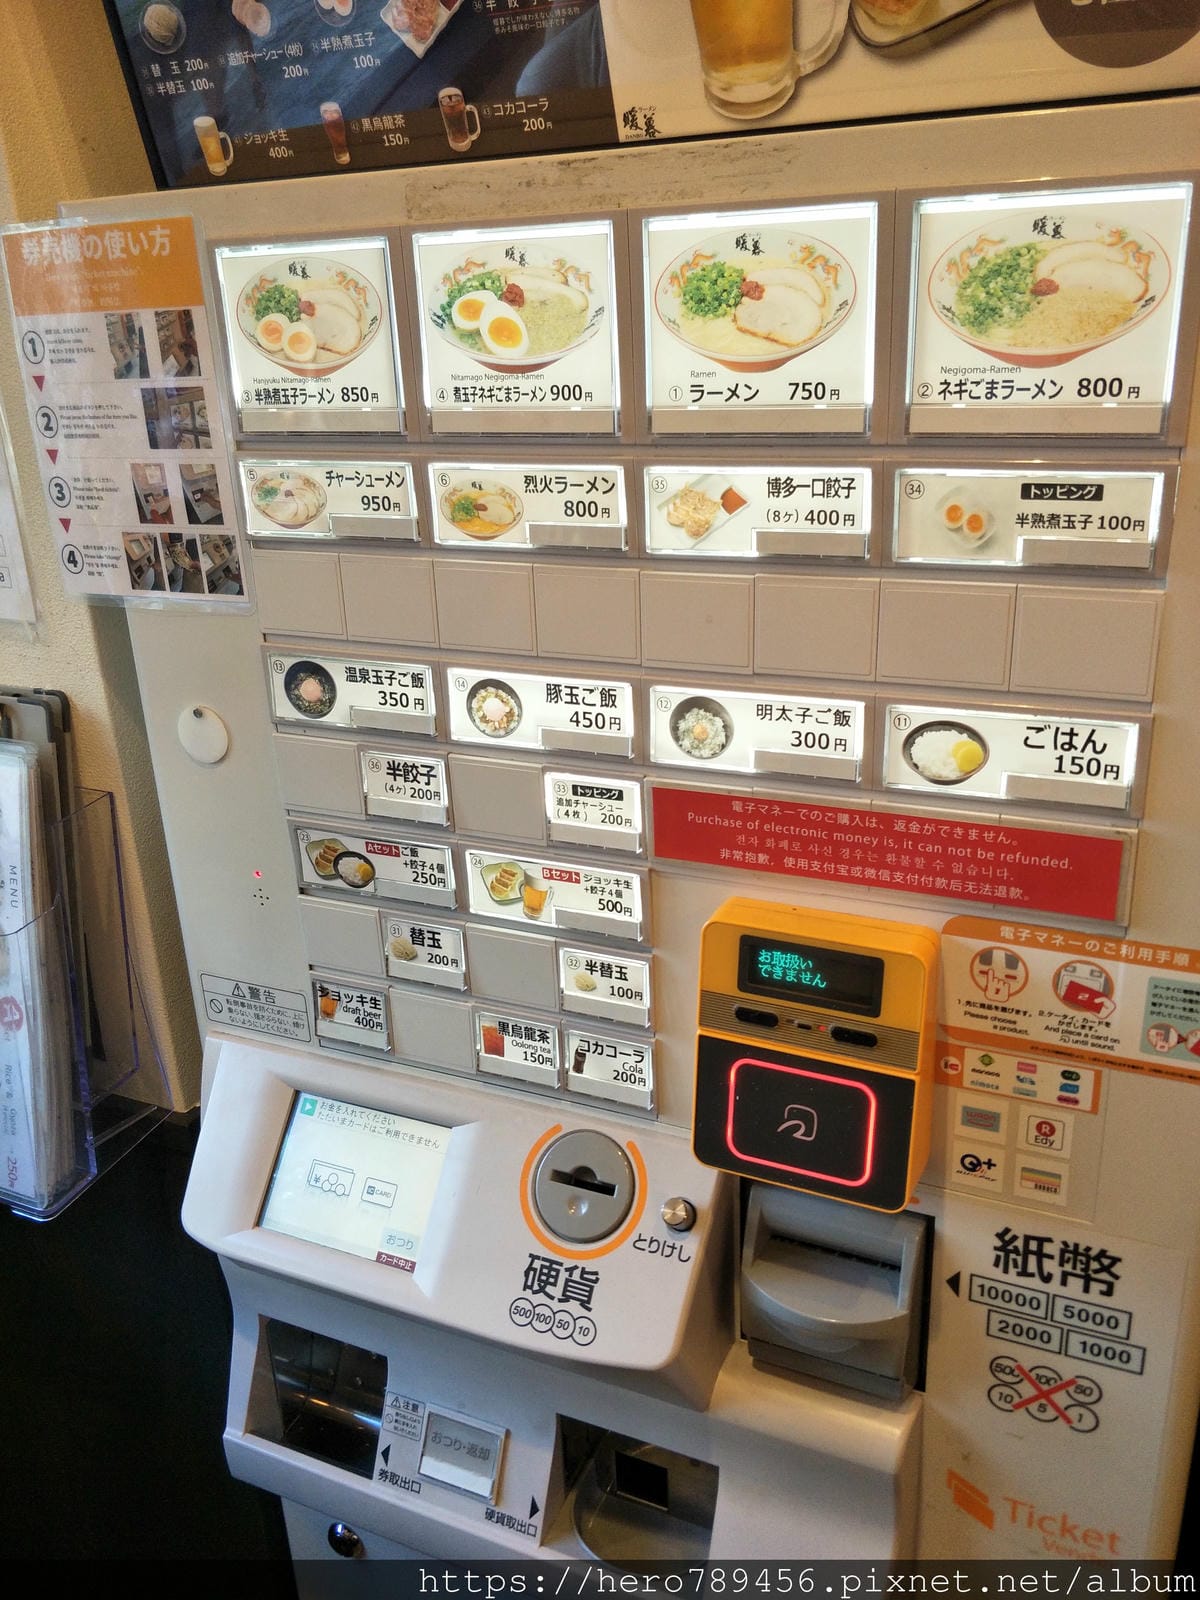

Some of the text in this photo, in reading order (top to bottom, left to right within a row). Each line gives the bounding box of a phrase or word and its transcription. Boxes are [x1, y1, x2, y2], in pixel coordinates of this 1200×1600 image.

[319, 32, 376, 53] 半熟煮玉子
[352, 54, 381, 69] 100円
[157, 80, 186, 96] 半替玉
[493, 97, 549, 116] コカコーラ
[244, 128, 289, 144] ジョッキ生
[451, 373, 483, 382] Nitamago
[690, 370, 717, 378] Ramen
[940, 365, 1021, 376] Negigoma-Ramen
[255, 387, 335, 405] 半熟煮玉子ラーメン
[453, 386, 547, 403] 煮玉子ネギごまラーメン
[689, 382, 760, 403] ラーメン
[937, 378, 1064, 401] ネギごまラーメン
[325, 470, 405, 488] チャーシューメン
[523, 475, 616, 495] 烈火ラーメン
[766, 476, 856, 499] 博多一口餃子
[1029, 484, 1098, 500] トッピング
[1015, 512, 1093, 531] 半熟煮玉子
[344, 666, 424, 689] 温泉玉子ご飯
[545, 683, 617, 709] 豚玉ご飯
[756, 703, 852, 728] 明太子ご飯
[1023, 724, 1108, 755] ごはん
[386, 760, 437, 786] 半餃子
[577, 785, 619, 799] トッピング
[556, 796, 624, 812] 追加チャーシュー
[731, 800, 1018, 846] 電子マネーでのご購入は、返金ができません。
[687, 812, 1073, 871] Purchase of electronic money is, it can not be refunded.
[401, 846, 419, 858] ご飯
[932, 860, 945, 871] 수
[9, 864, 19, 909] MENU
[543, 868, 633, 890] Bセット ジョッキ生
[409, 926, 442, 950] 替玉
[999, 925, 1190, 967] 電子マネーのご利用手順
[757, 949, 813, 969] お取扱い
[584, 959, 629, 982] 半替玉
[757, 963, 827, 988] できません
[247, 986, 276, 1004] 警告
[343, 1004, 382, 1020] draft beer
[963, 1011, 1017, 1025] Please choose
[497, 1021, 551, 1045] 黒烏龍茶
[1044, 1025, 1060, 1034] And
[1061, 1028, 1082, 1038] place
[1090, 1032, 1109, 1042] card
[1071, 1037, 1089, 1046] until
[511, 1039, 552, 1055] Oolong tea
[579, 1038, 645, 1064] コカコーラ
[622, 1062, 644, 1075] Cola
[319, 1101, 396, 1126] お金を入れてください
[317, 1112, 440, 1149] ただいまカードはご利用できません
[1034, 1135, 1055, 1147] Edy
[386, 1234, 414, 1250] おつり
[632, 1232, 691, 1263] とりけし
[379, 1253, 413, 1270] カード中止
[993, 1226, 1123, 1298] 紙幣
[522, 1253, 600, 1312] 硬貨
[976, 1283, 1119, 1330] 10000 5000
[512, 1305, 590, 1337] 500 100 50 10
[997, 1319, 1131, 1365] 2000 1000
[998, 1392, 1014, 1404] 10
[1073, 1385, 1093, 1397] 50
[402, 1400, 419, 1414] 注意
[430, 1431, 490, 1461] おつり・返却
[378, 1468, 422, 1494] 券取出口
[484, 1507, 538, 1538] 硬貨取出口
[1003, 1497, 1121, 1556] Ticket
